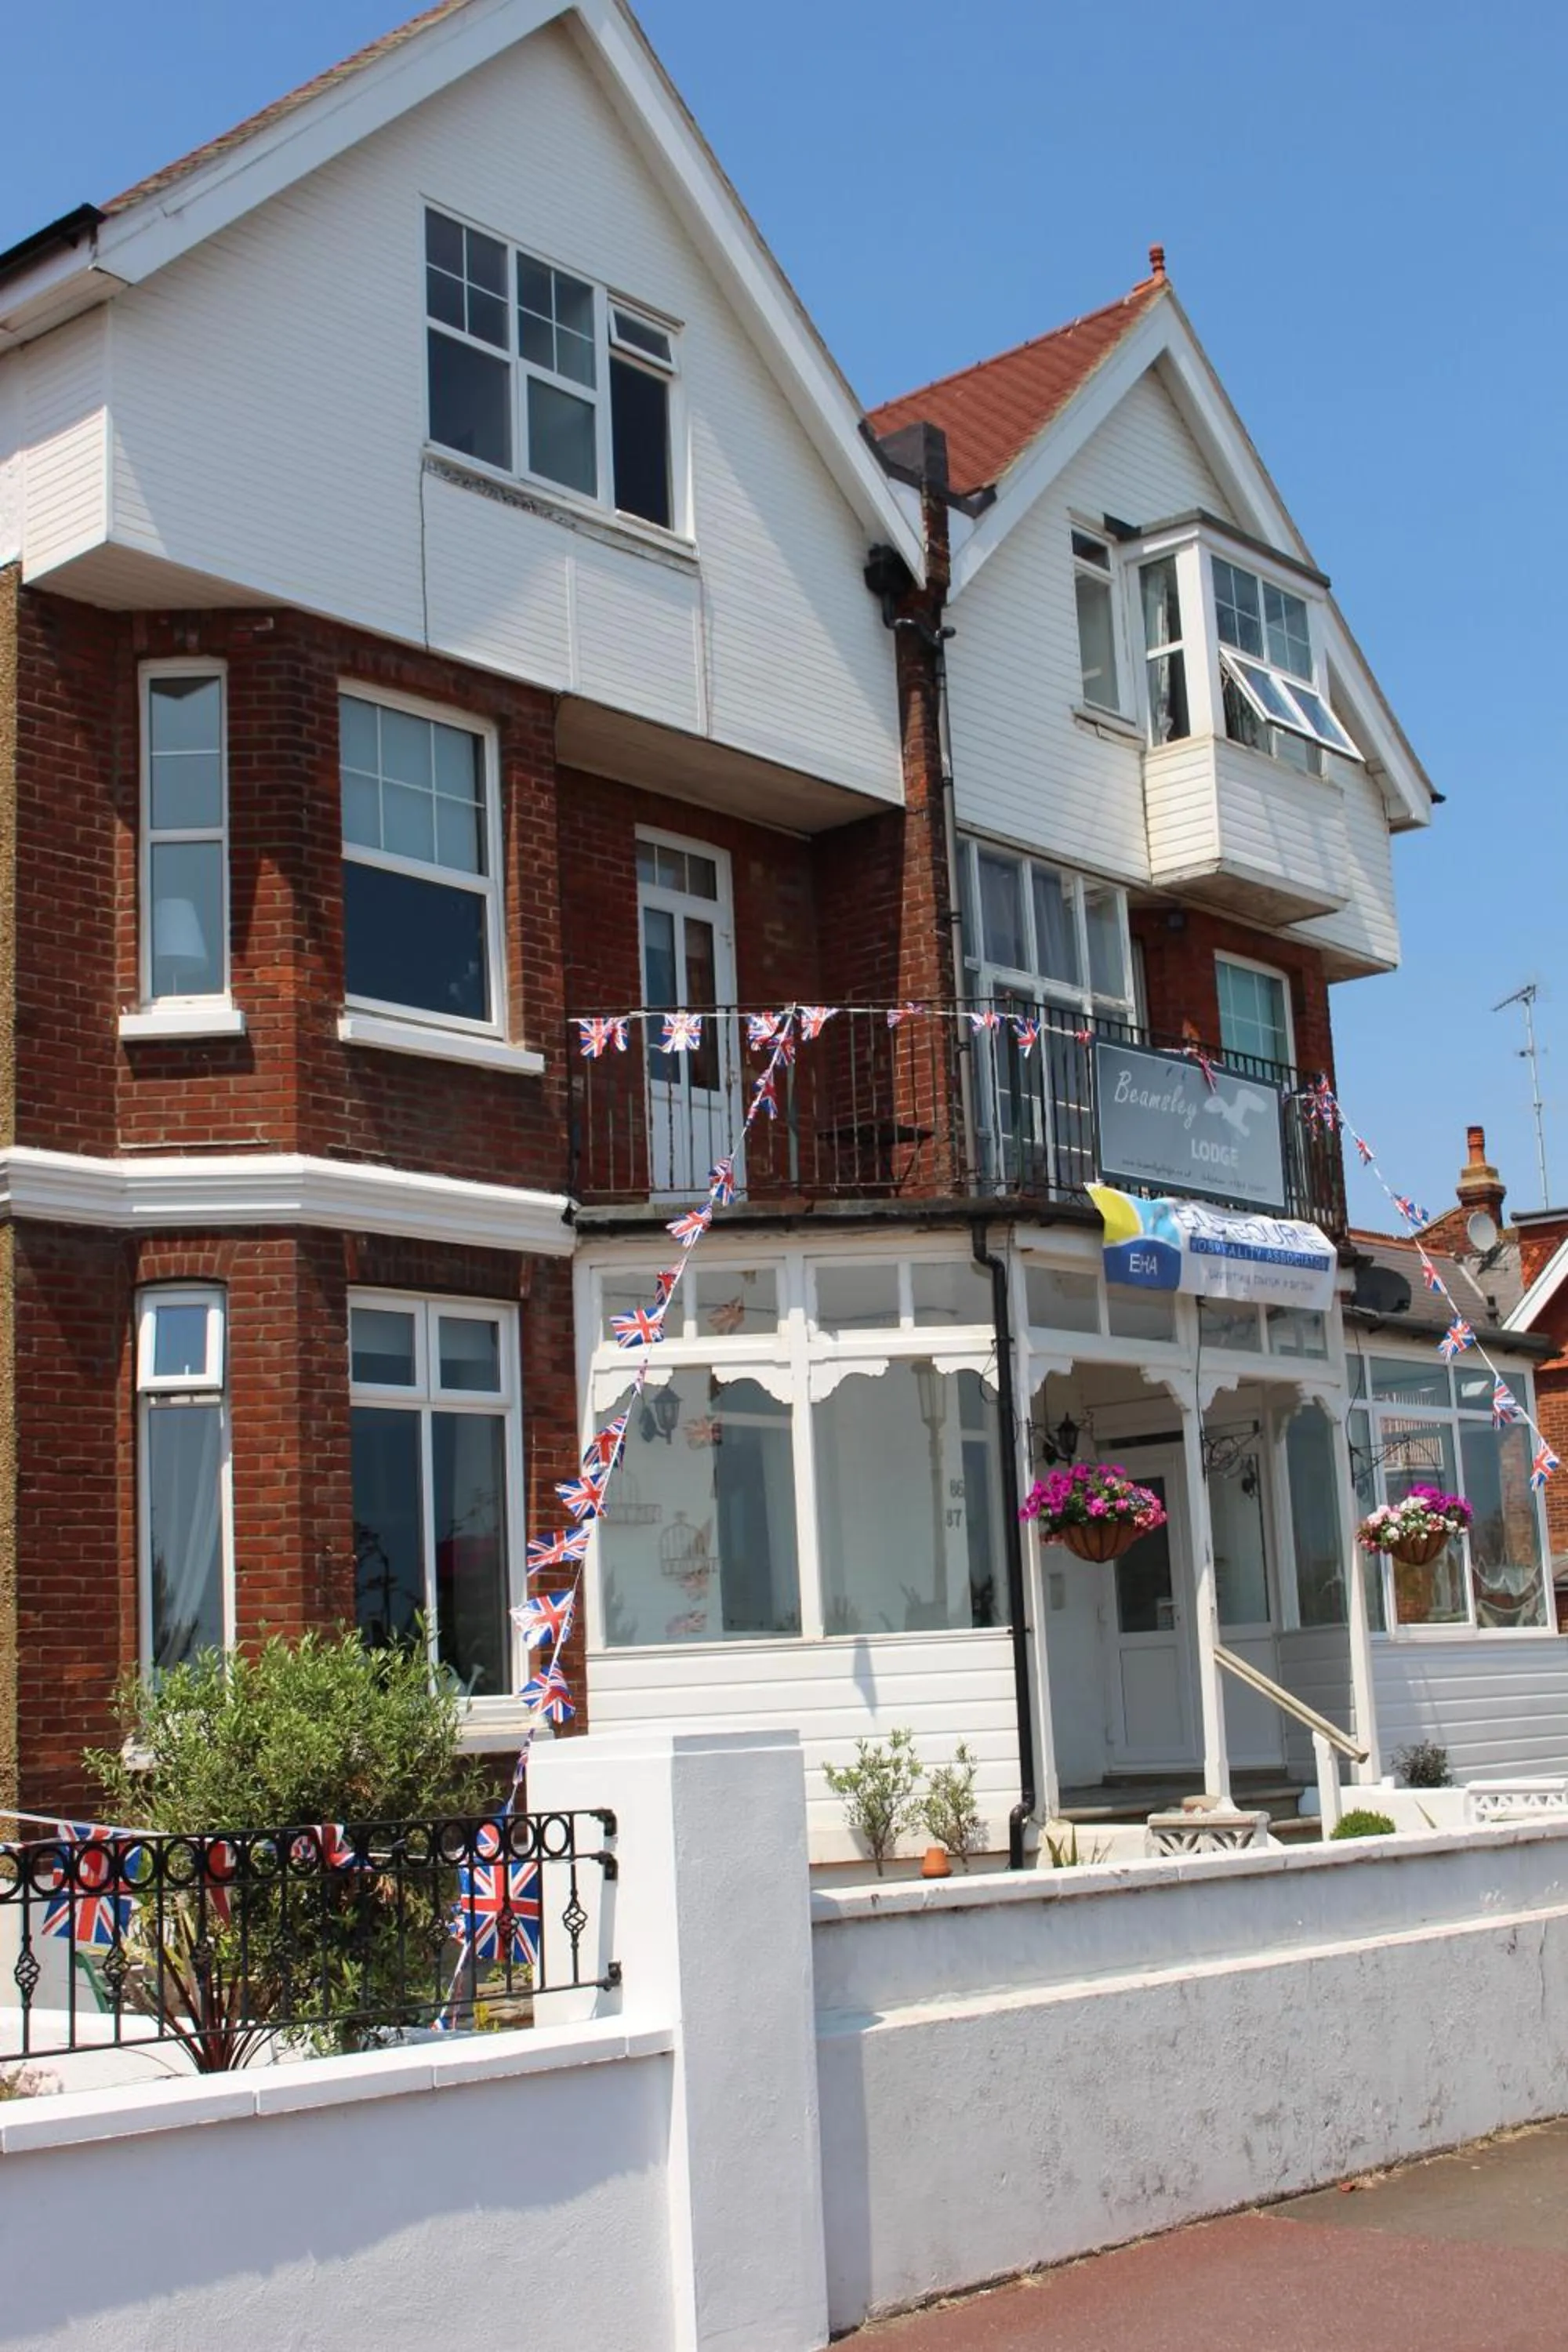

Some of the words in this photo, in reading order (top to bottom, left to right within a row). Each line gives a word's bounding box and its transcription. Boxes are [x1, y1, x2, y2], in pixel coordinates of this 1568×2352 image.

[1114, 1070, 1196, 1129] Beamsley
[1191, 1138, 1239, 1169] LODGE
[1129, 1254, 1157, 1276] EHA
